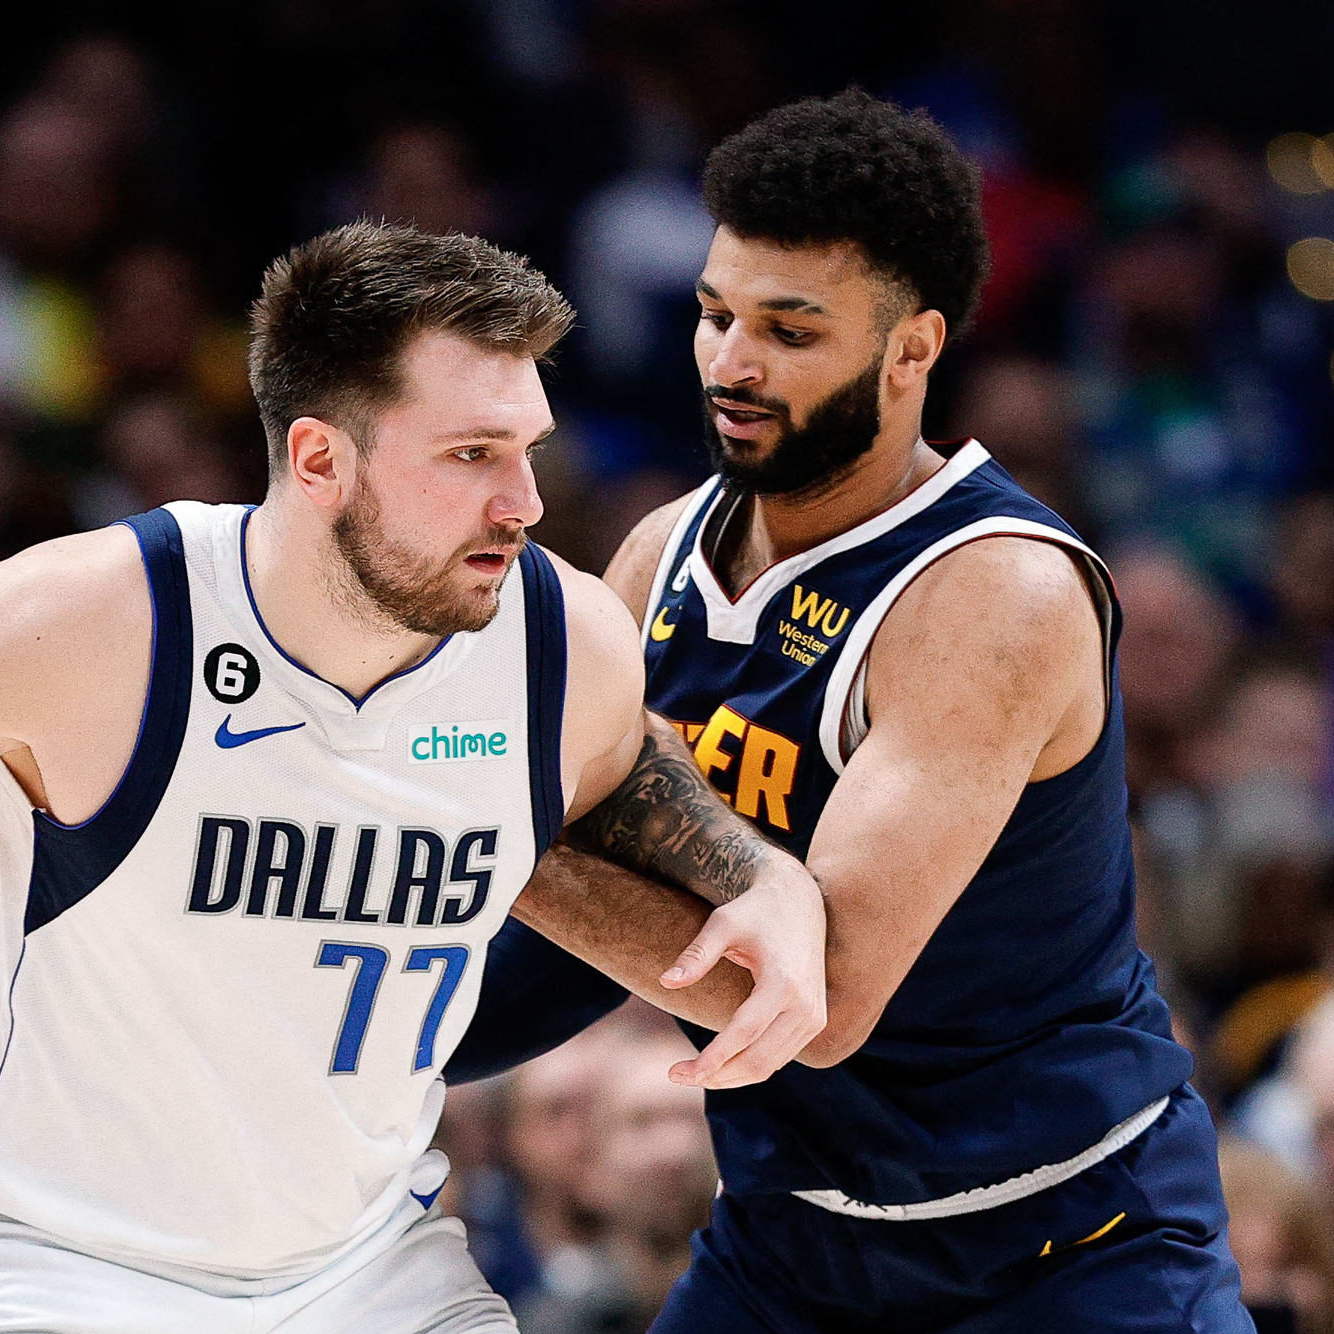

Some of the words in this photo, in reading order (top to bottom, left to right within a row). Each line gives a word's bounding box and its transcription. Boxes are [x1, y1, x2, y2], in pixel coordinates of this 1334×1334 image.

[790, 584, 851, 637] WU
[215, 652, 247, 698] 6
[781, 640, 818, 667] Union
[410, 725, 509, 761] chime
[183, 812, 503, 928] DALLAS
[313, 939, 473, 1077] 77
